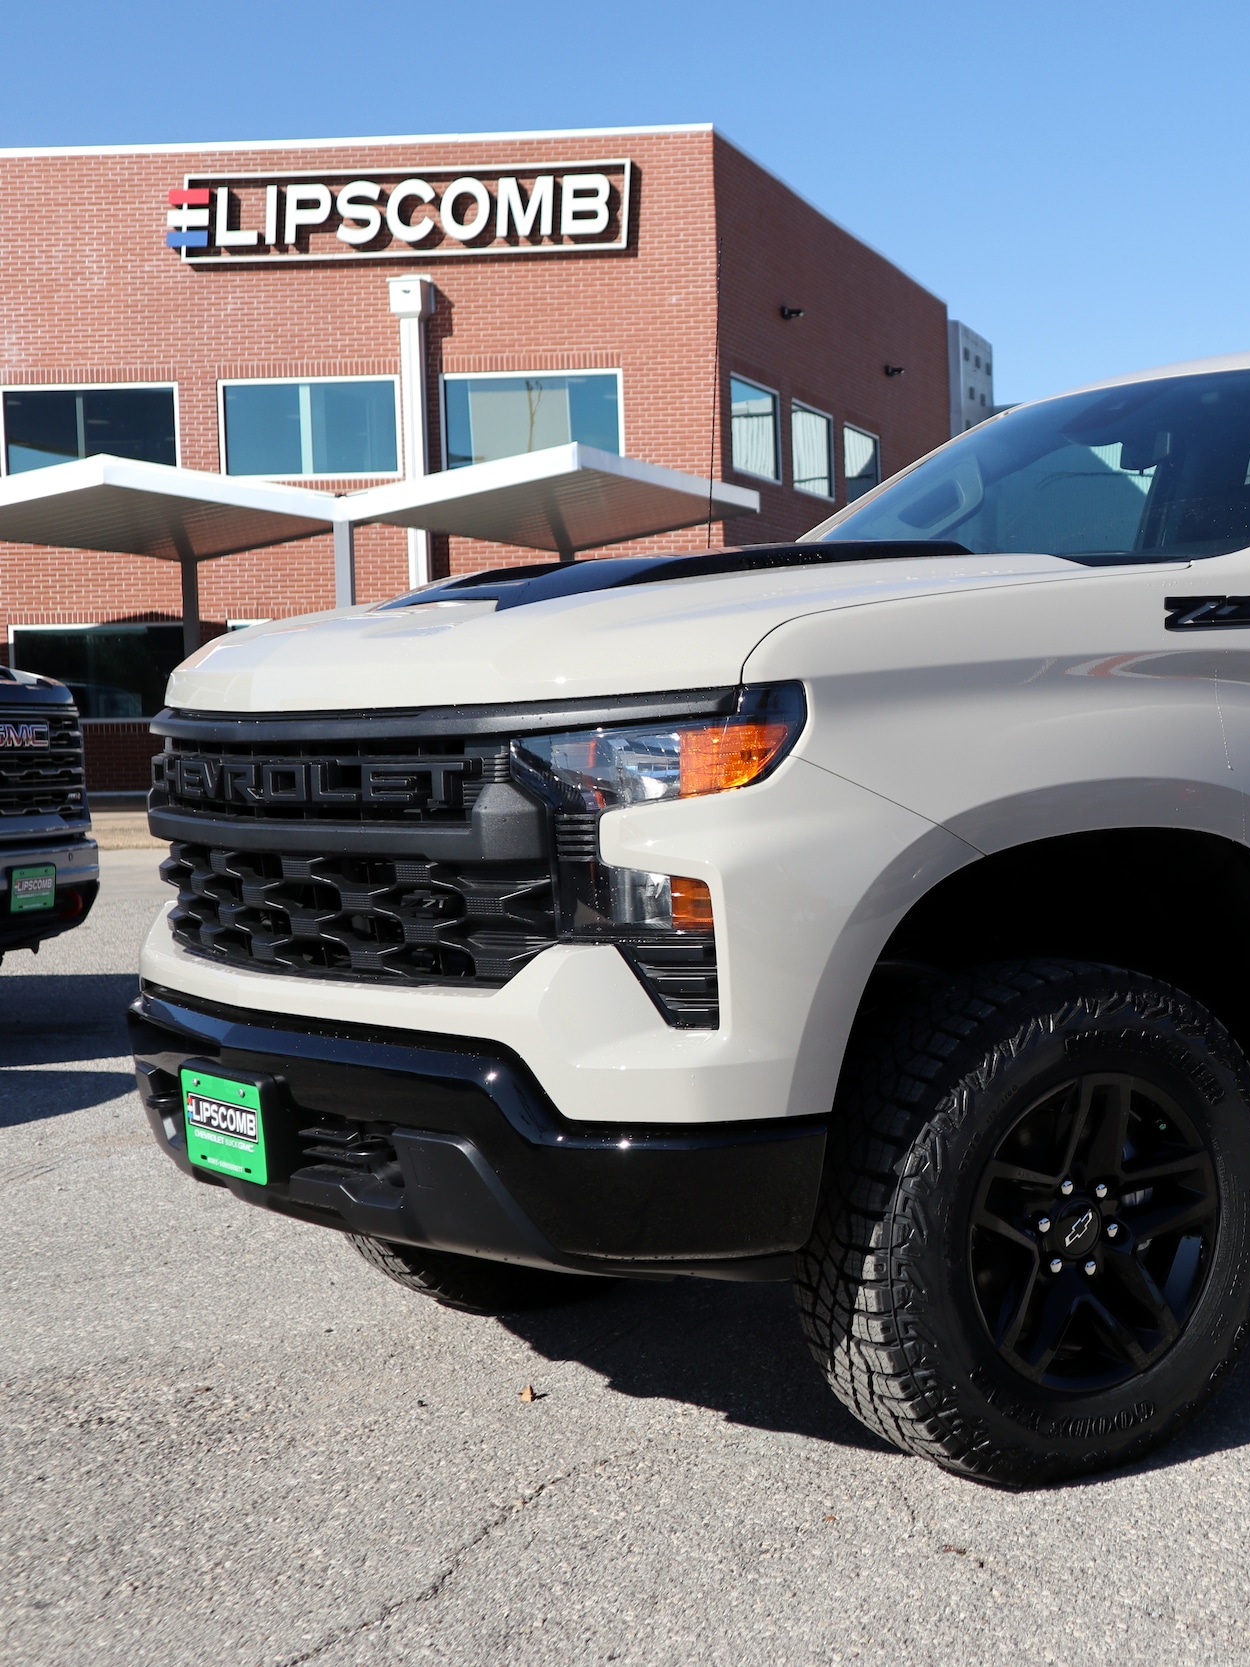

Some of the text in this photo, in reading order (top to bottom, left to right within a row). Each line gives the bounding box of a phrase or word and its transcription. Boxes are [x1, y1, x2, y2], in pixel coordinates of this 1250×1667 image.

[215, 173, 611, 247] LIPSCOMB
[151, 755, 466, 801] CHEVROLET
[17, 878, 52, 892] LIPSCOMB
[192, 1099, 256, 1137] LIPSCOMB
[194, 1129, 225, 1144] CHEVROLET
[238, 1141, 254, 1153] GMC
